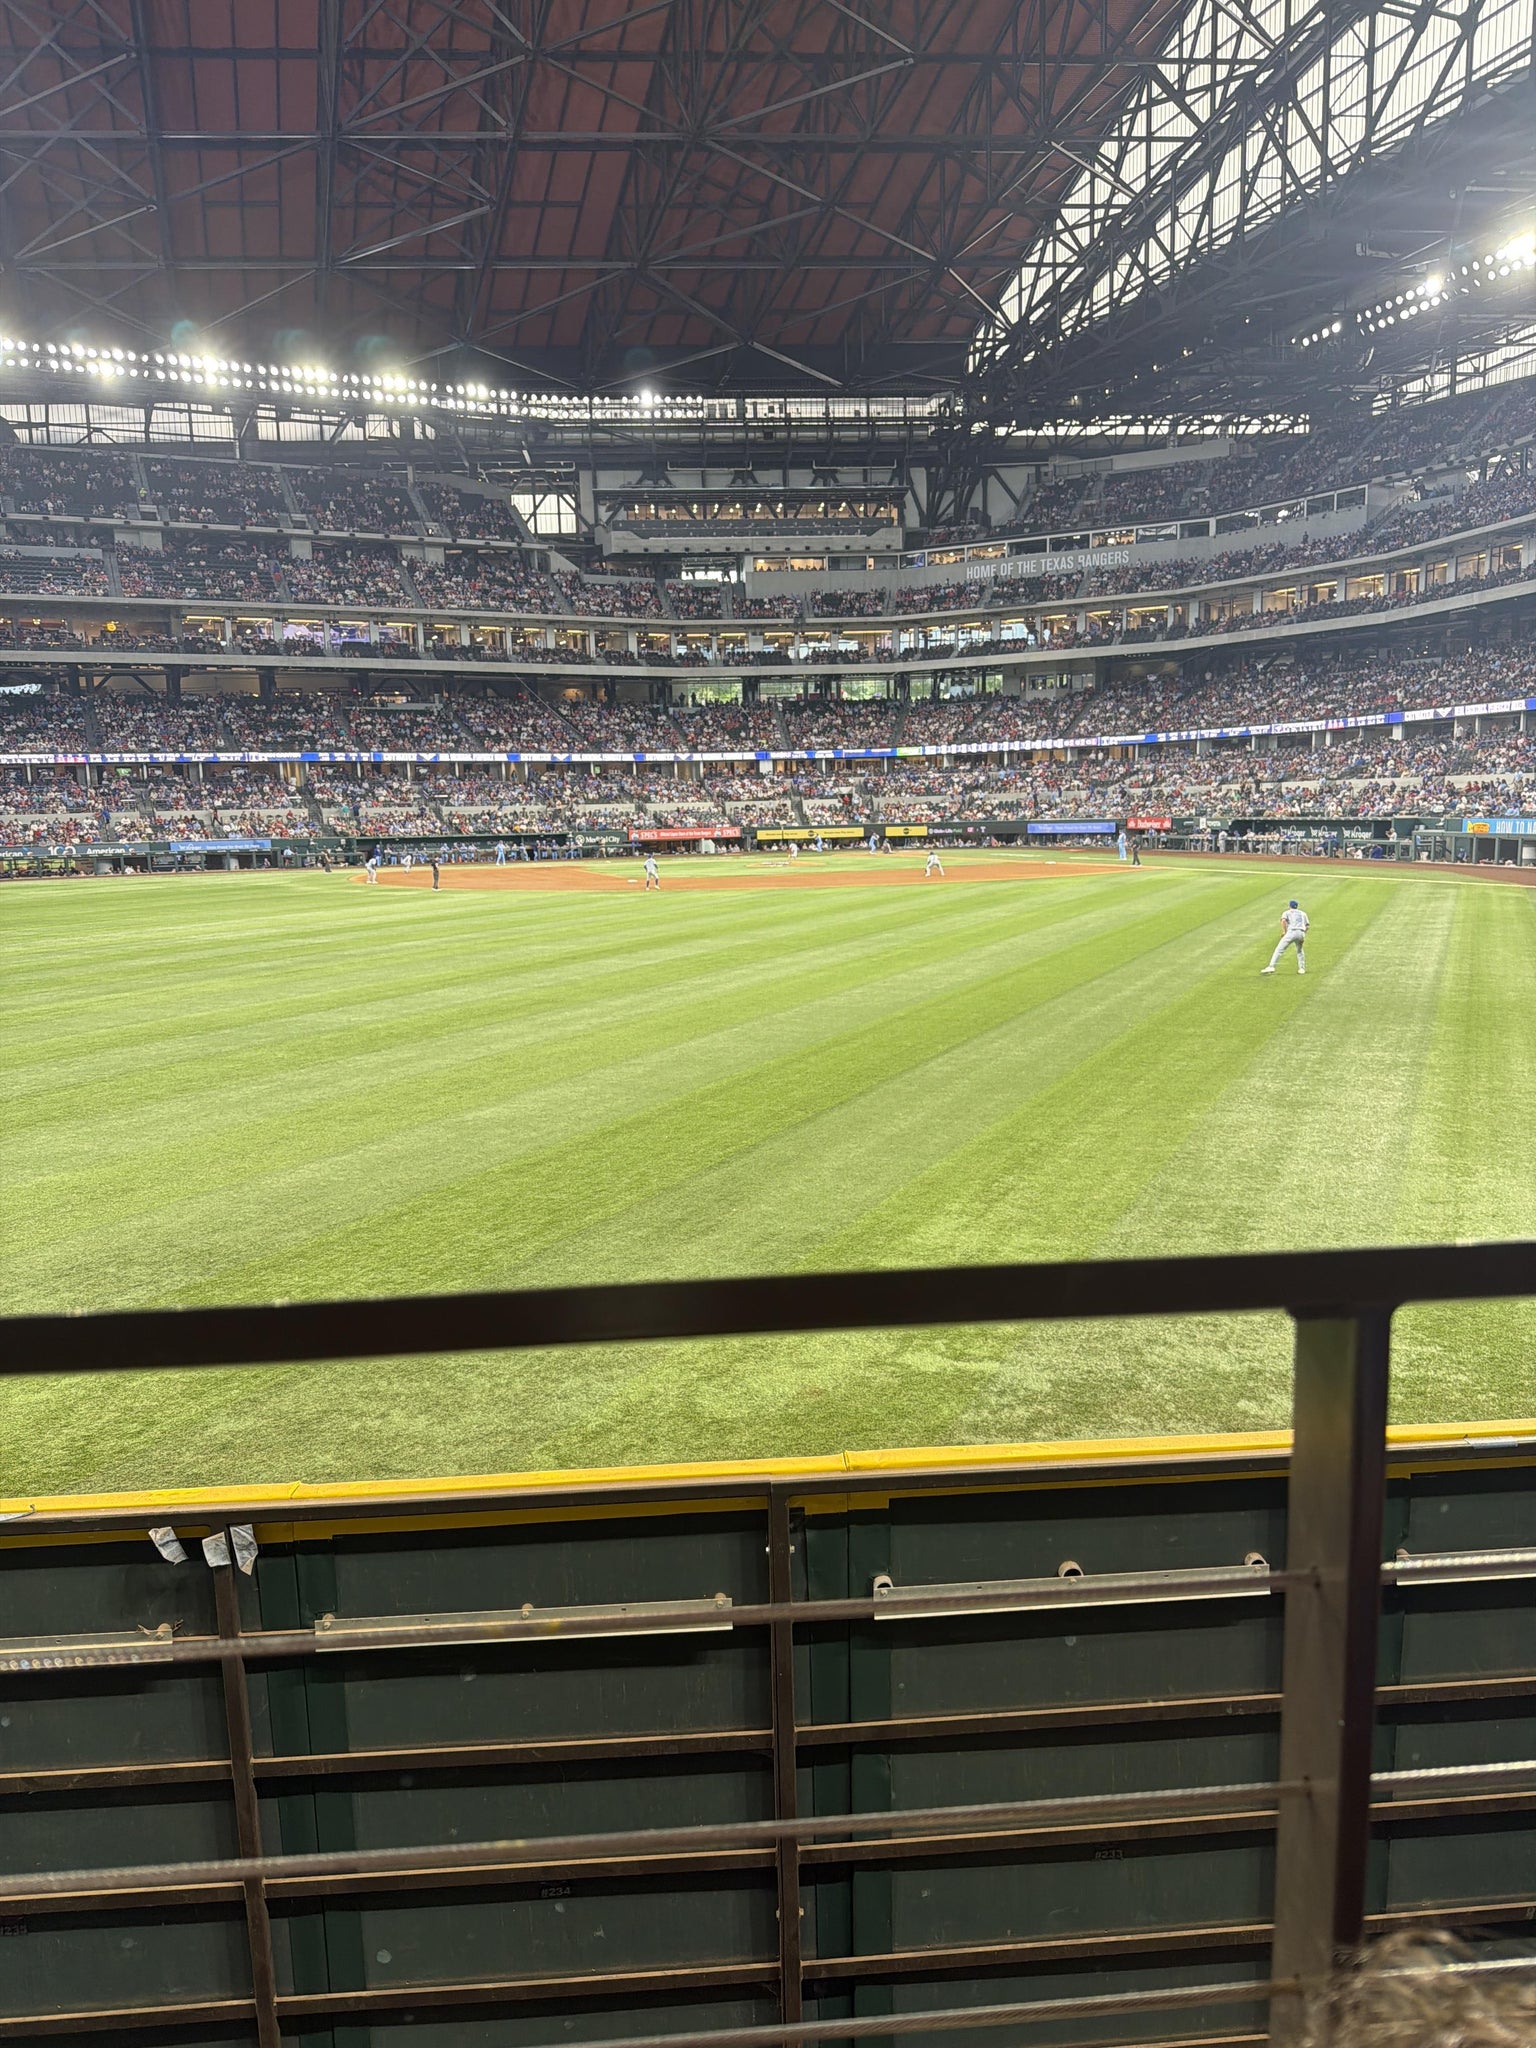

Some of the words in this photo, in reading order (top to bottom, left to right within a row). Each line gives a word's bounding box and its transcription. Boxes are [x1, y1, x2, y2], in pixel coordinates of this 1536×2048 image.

[966, 564, 997, 580] HOME
[1000, 562, 1014, 577] OF
[1017, 560, 1037, 574] THE
[1040, 556, 1074, 572] TEXAS
[1078, 550, 1129, 567] RANGERS
[1350, 825, 1372, 839] Kroger
[1496, 820, 1513, 834] HOW
[1515, 820, 1525, 834] TO
[87, 847, 126, 855] American
